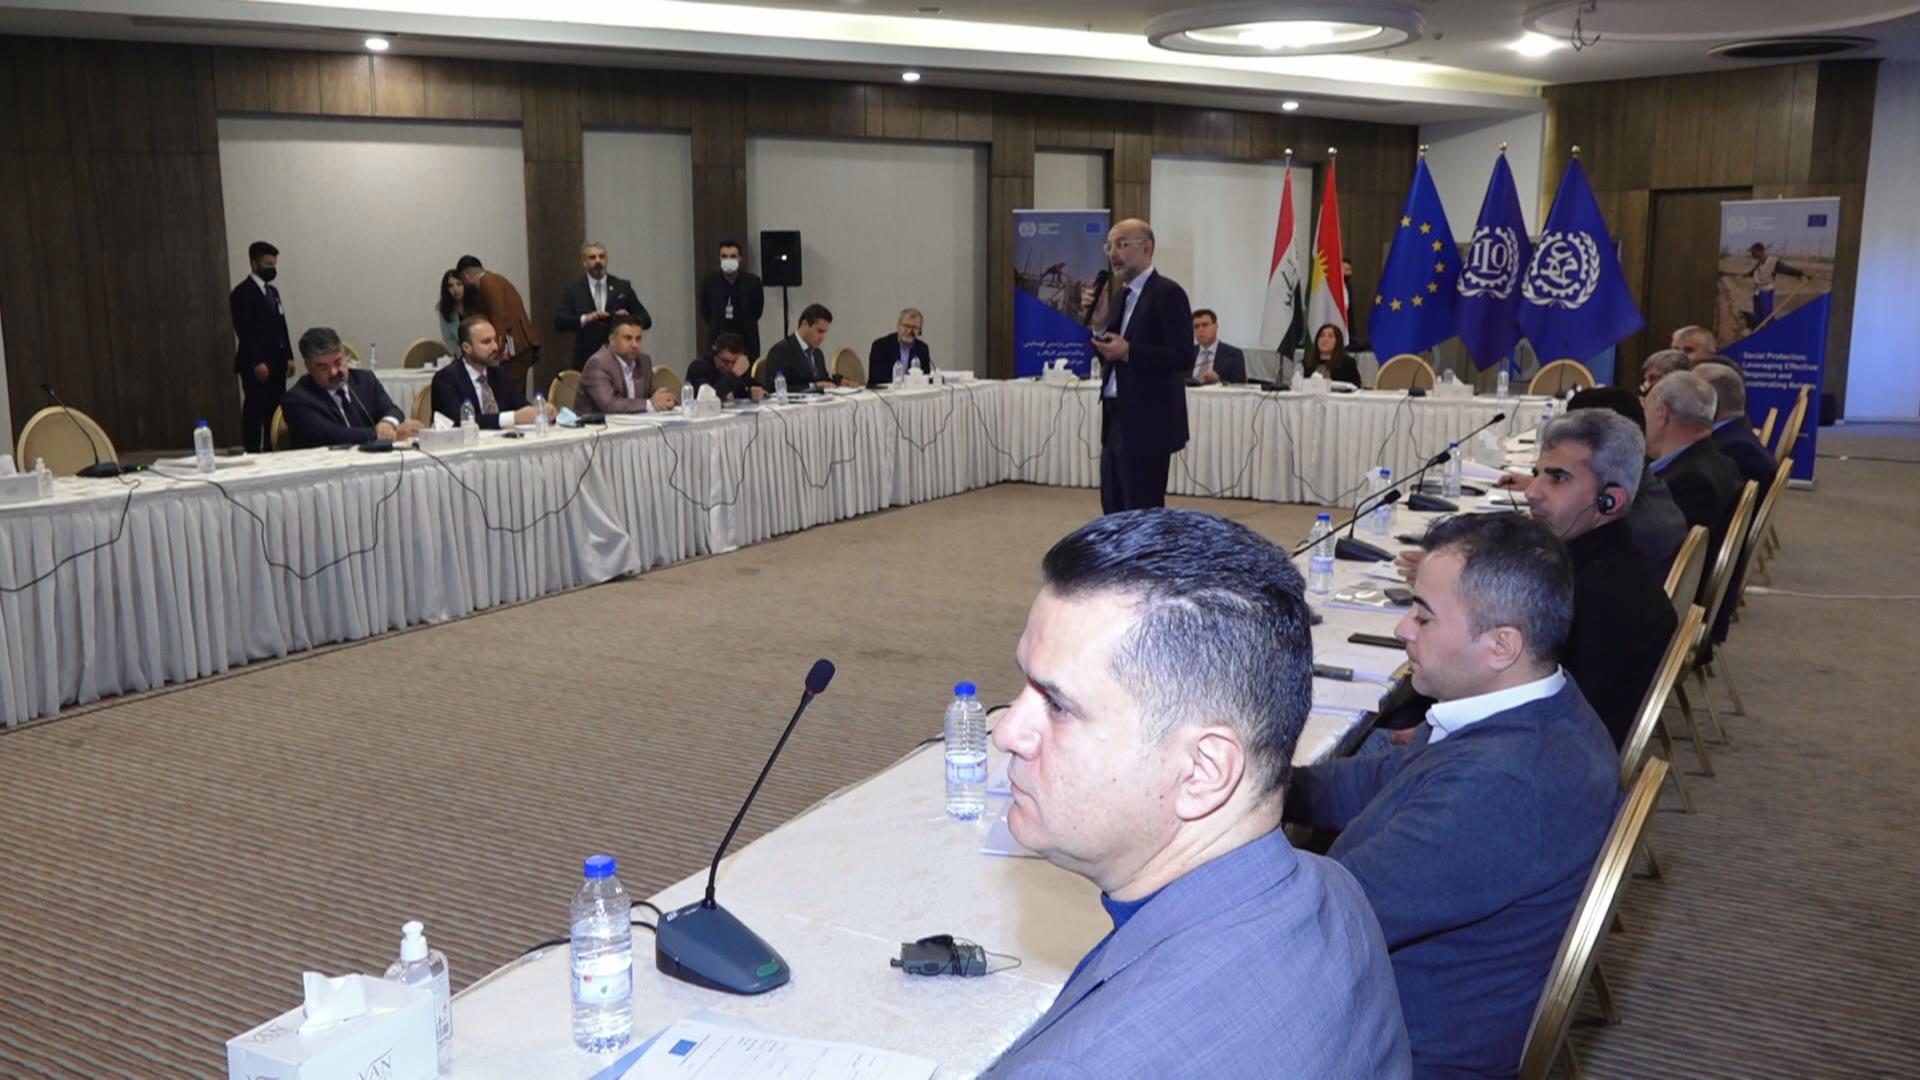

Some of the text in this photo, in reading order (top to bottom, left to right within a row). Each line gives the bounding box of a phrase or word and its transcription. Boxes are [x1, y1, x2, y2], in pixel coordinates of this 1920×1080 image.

[1471, 238, 1508, 275] ILO
[1743, 351, 1765, 360] Social
[1742, 361, 1818, 371] Leveraging Effective
[1778, 372, 1792, 380] and
